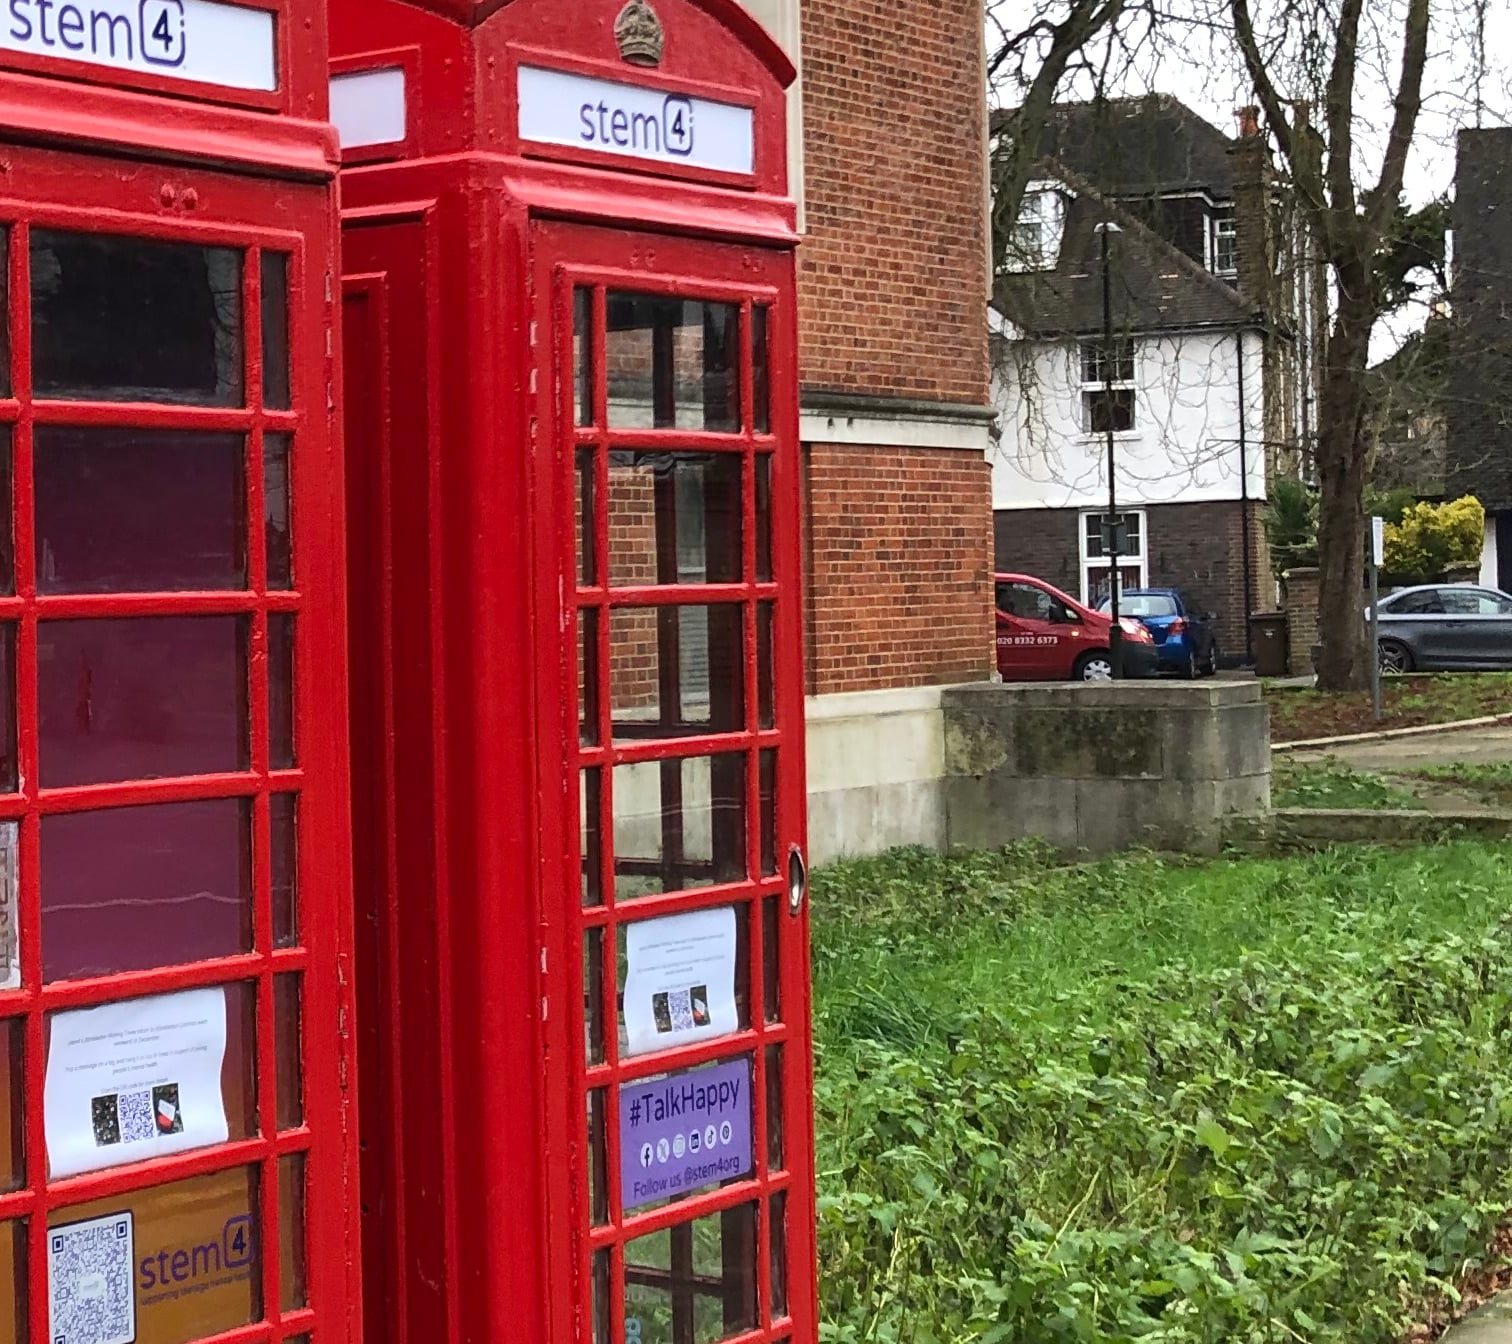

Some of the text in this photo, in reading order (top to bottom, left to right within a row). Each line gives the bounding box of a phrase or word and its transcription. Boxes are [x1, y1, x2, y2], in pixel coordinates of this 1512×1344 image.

[579, 94, 694, 156] stem4
[629, 1078, 740, 1128] #TalkHappy
[633, 1156, 740, 1198] Follow us @stem4org
[139, 1213, 255, 1290] stem4
